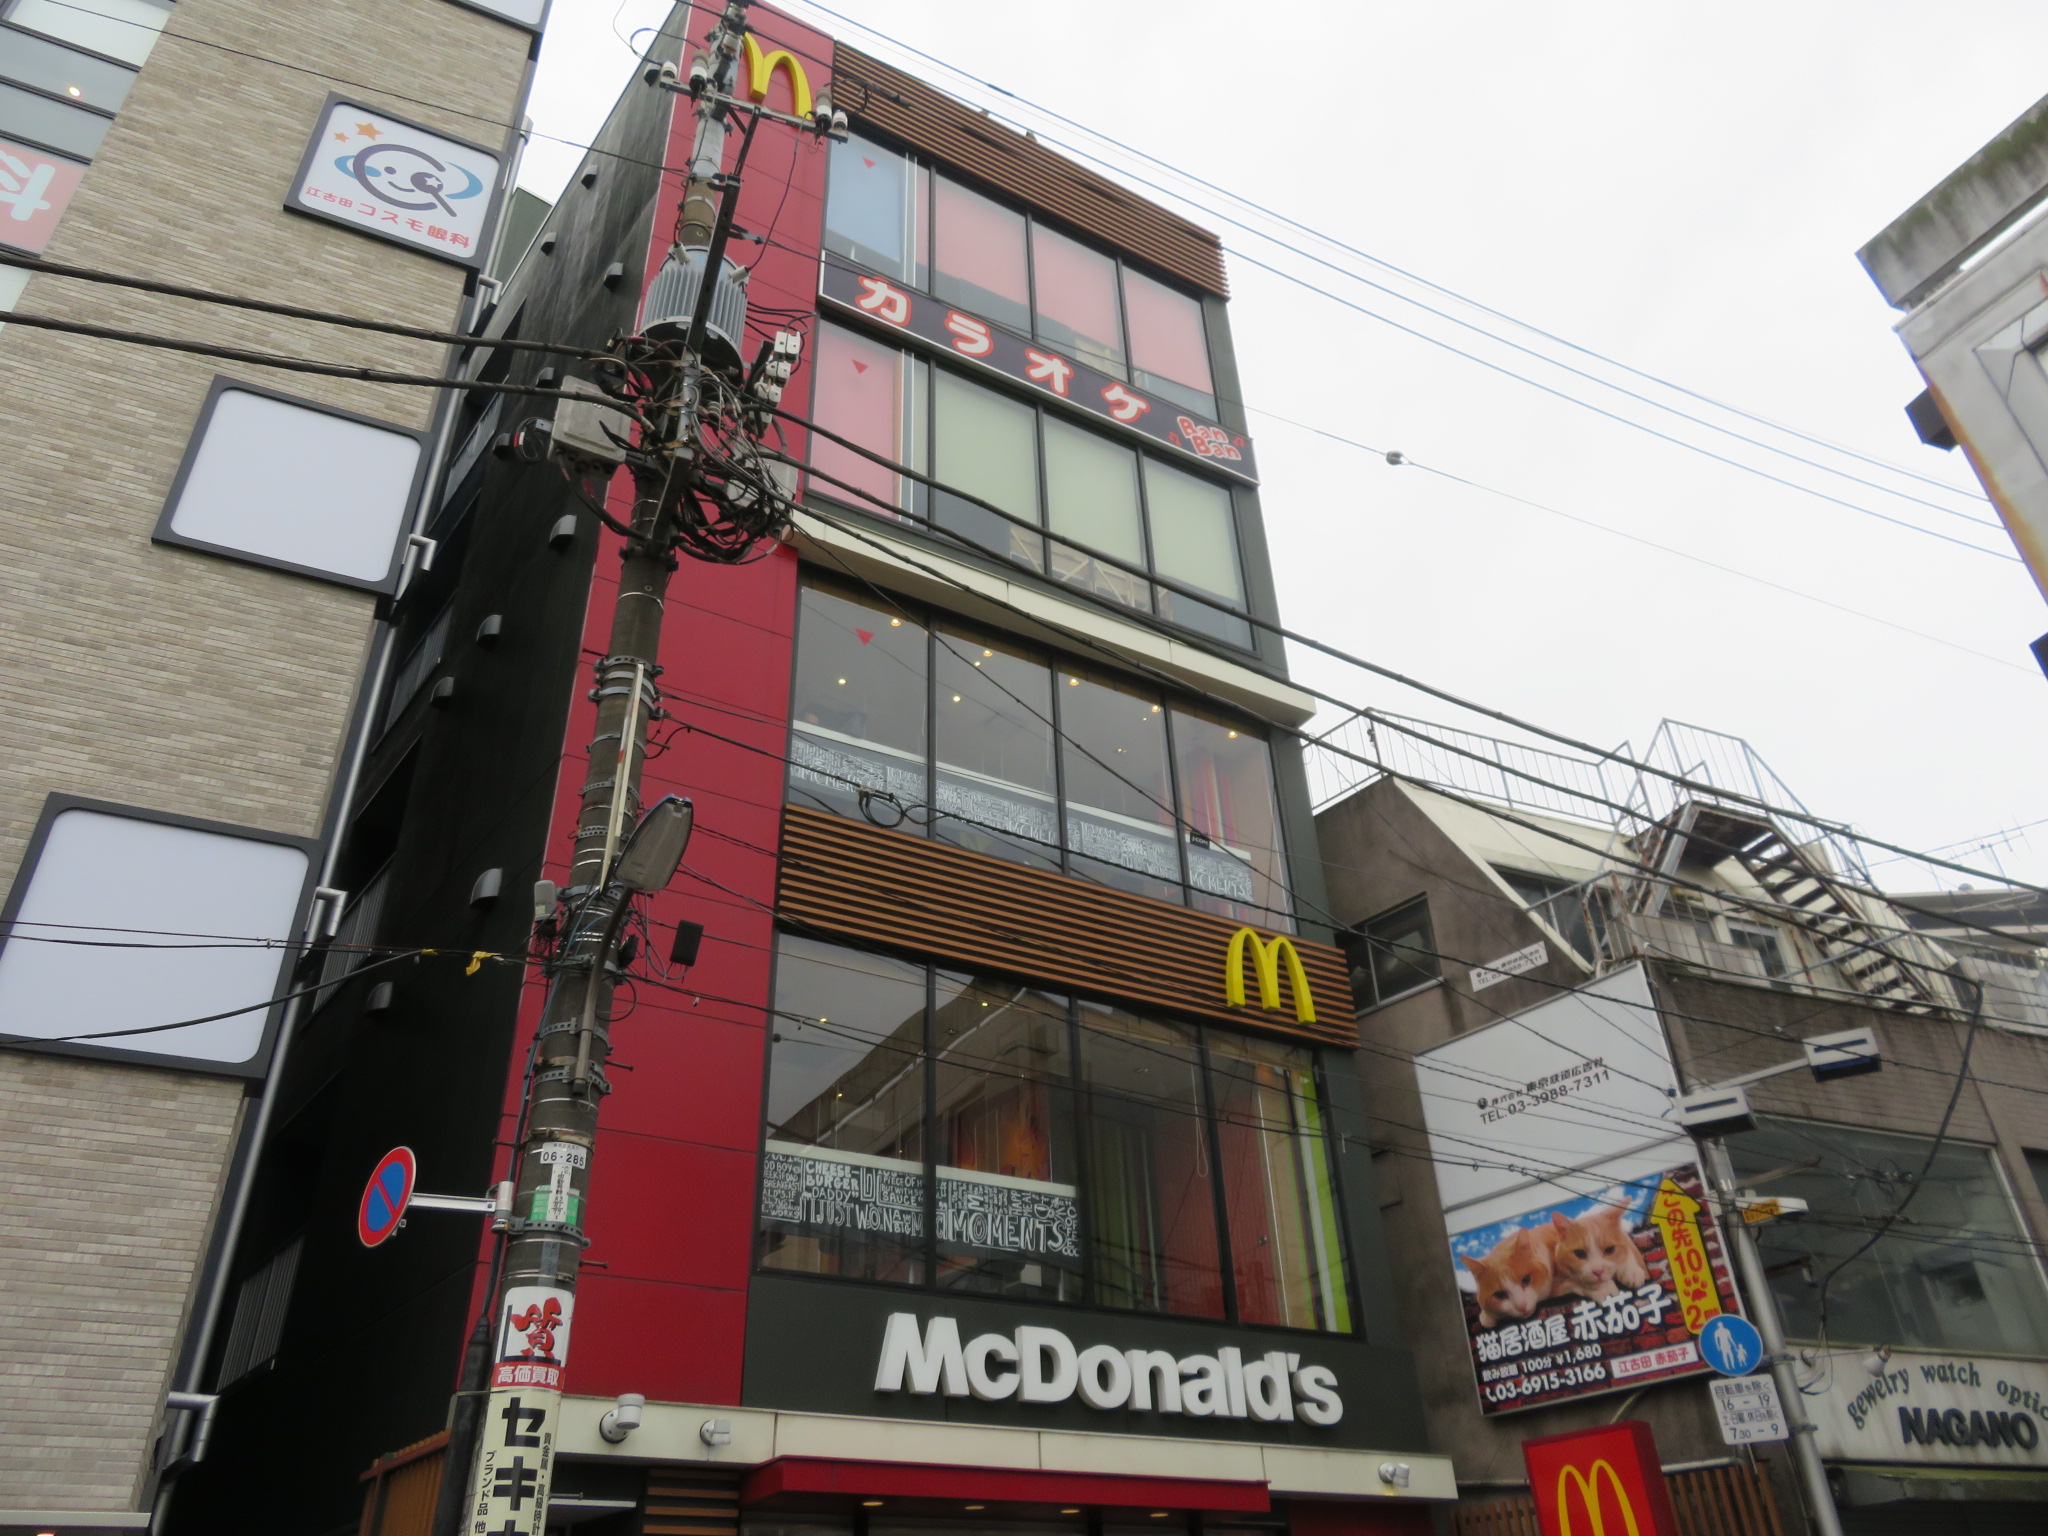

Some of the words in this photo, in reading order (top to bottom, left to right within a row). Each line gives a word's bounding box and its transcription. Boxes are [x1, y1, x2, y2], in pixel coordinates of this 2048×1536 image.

[855, 275, 1150, 423] カラオケ
[1191, 434, 1241, 461] Ban
[806, 1175, 859, 1191] BURGER
[948, 1208, 1067, 1253] MOMENTS
[1476, 1313, 1571, 1363] 猫居酒屋
[1571, 1283, 1672, 1341] 赤茄子
[497, 1365, 559, 1386] 高価買取
[874, 1312, 1344, 1427] McDonald's
[1495, 1365, 1606, 1399] 03-6915-3166
[1920, 1361, 1981, 1388] watch
[1759, 1394, 1770, 1407] 19
[1898, 1406, 2039, 1450] NAGANO
